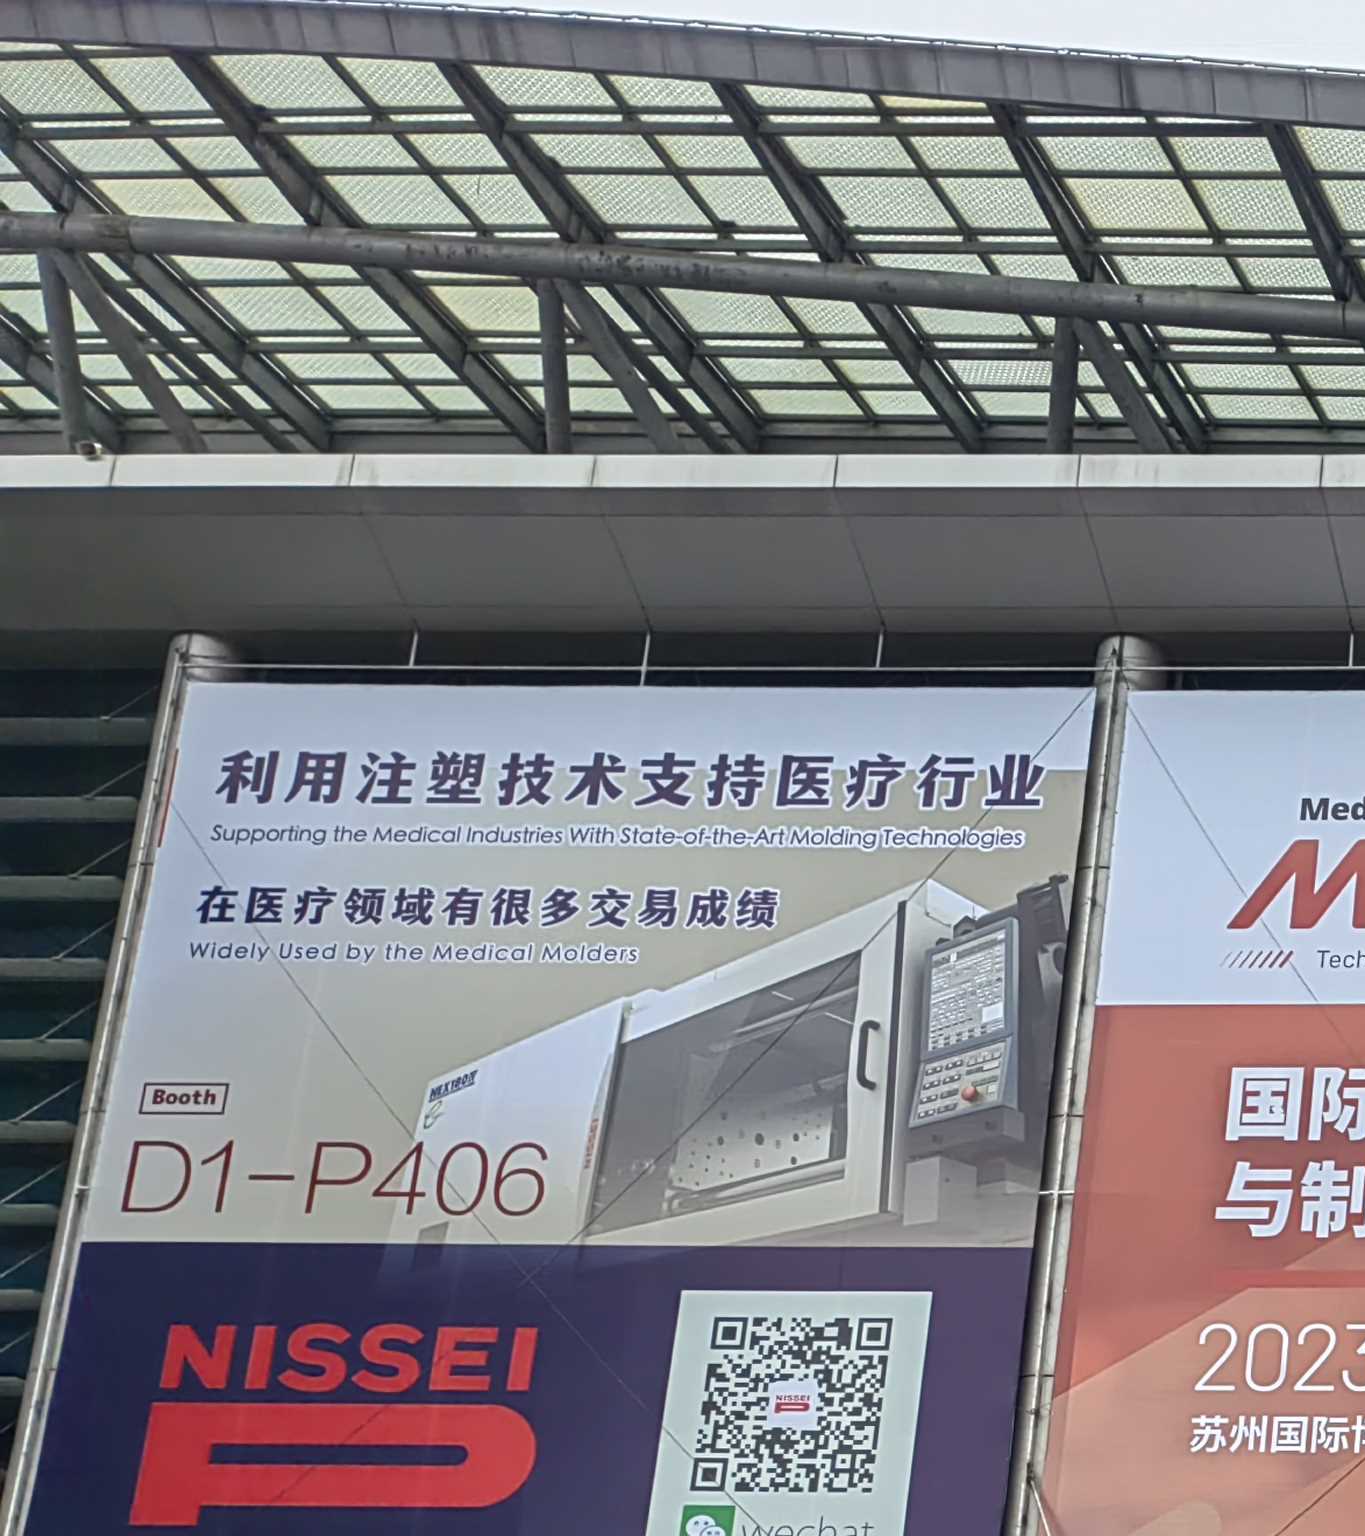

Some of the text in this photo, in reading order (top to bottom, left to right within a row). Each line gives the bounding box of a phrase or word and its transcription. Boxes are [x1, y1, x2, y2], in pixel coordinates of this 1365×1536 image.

[216, 749, 1047, 808] 利用注塑技术支持医疗行业
[211, 823, 1023, 850] Supporting the Medical Industries With State-of-the-Art Molding Technologies
[194, 885, 780, 930] 在医疗领域有很多交易成绩
[188, 941, 638, 964] Widely Used by the Medical Molders
[152, 1089, 216, 1105] Booth
[121, 1140, 548, 1216] D1-P406
[159, 1323, 539, 1392] NISSEI
